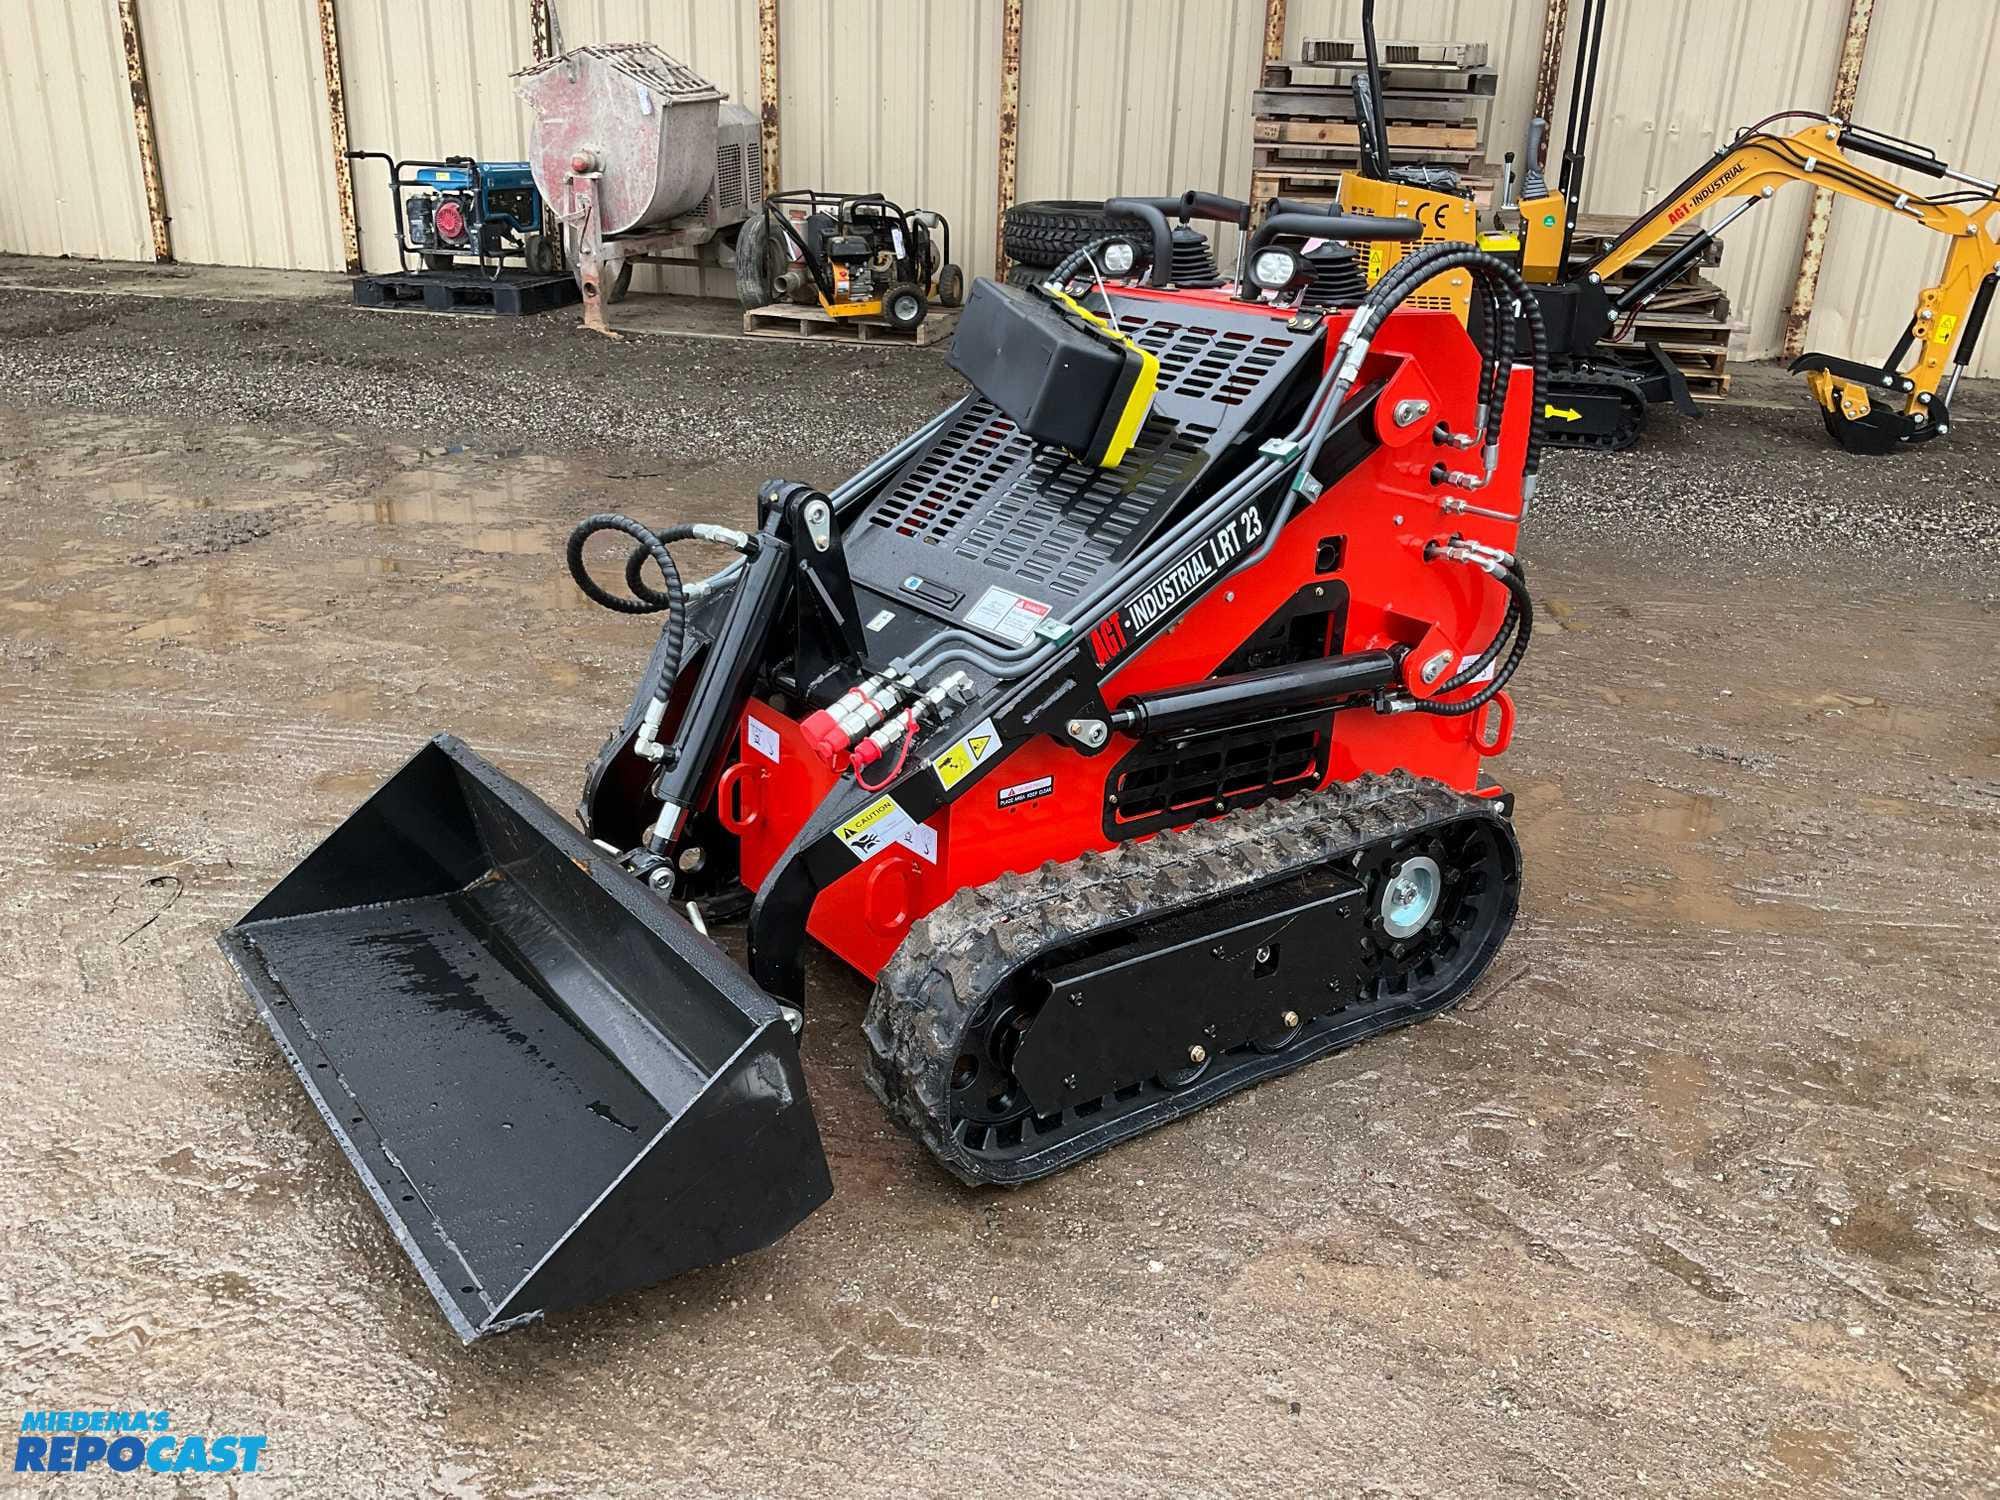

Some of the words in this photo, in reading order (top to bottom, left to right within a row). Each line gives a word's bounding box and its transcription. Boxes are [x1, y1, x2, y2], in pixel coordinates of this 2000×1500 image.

[1668, 203, 1690, 225] AGT
[1692, 163, 1745, 206] INDUSTRIAL
[1090, 612, 1127, 669] AGT
[1128, 552, 1212, 631] INDUSTRIAL
[1210, 520, 1241, 568] LRT
[1240, 506, 1263, 544] 23
[855, 801, 892, 828] CAUTION
